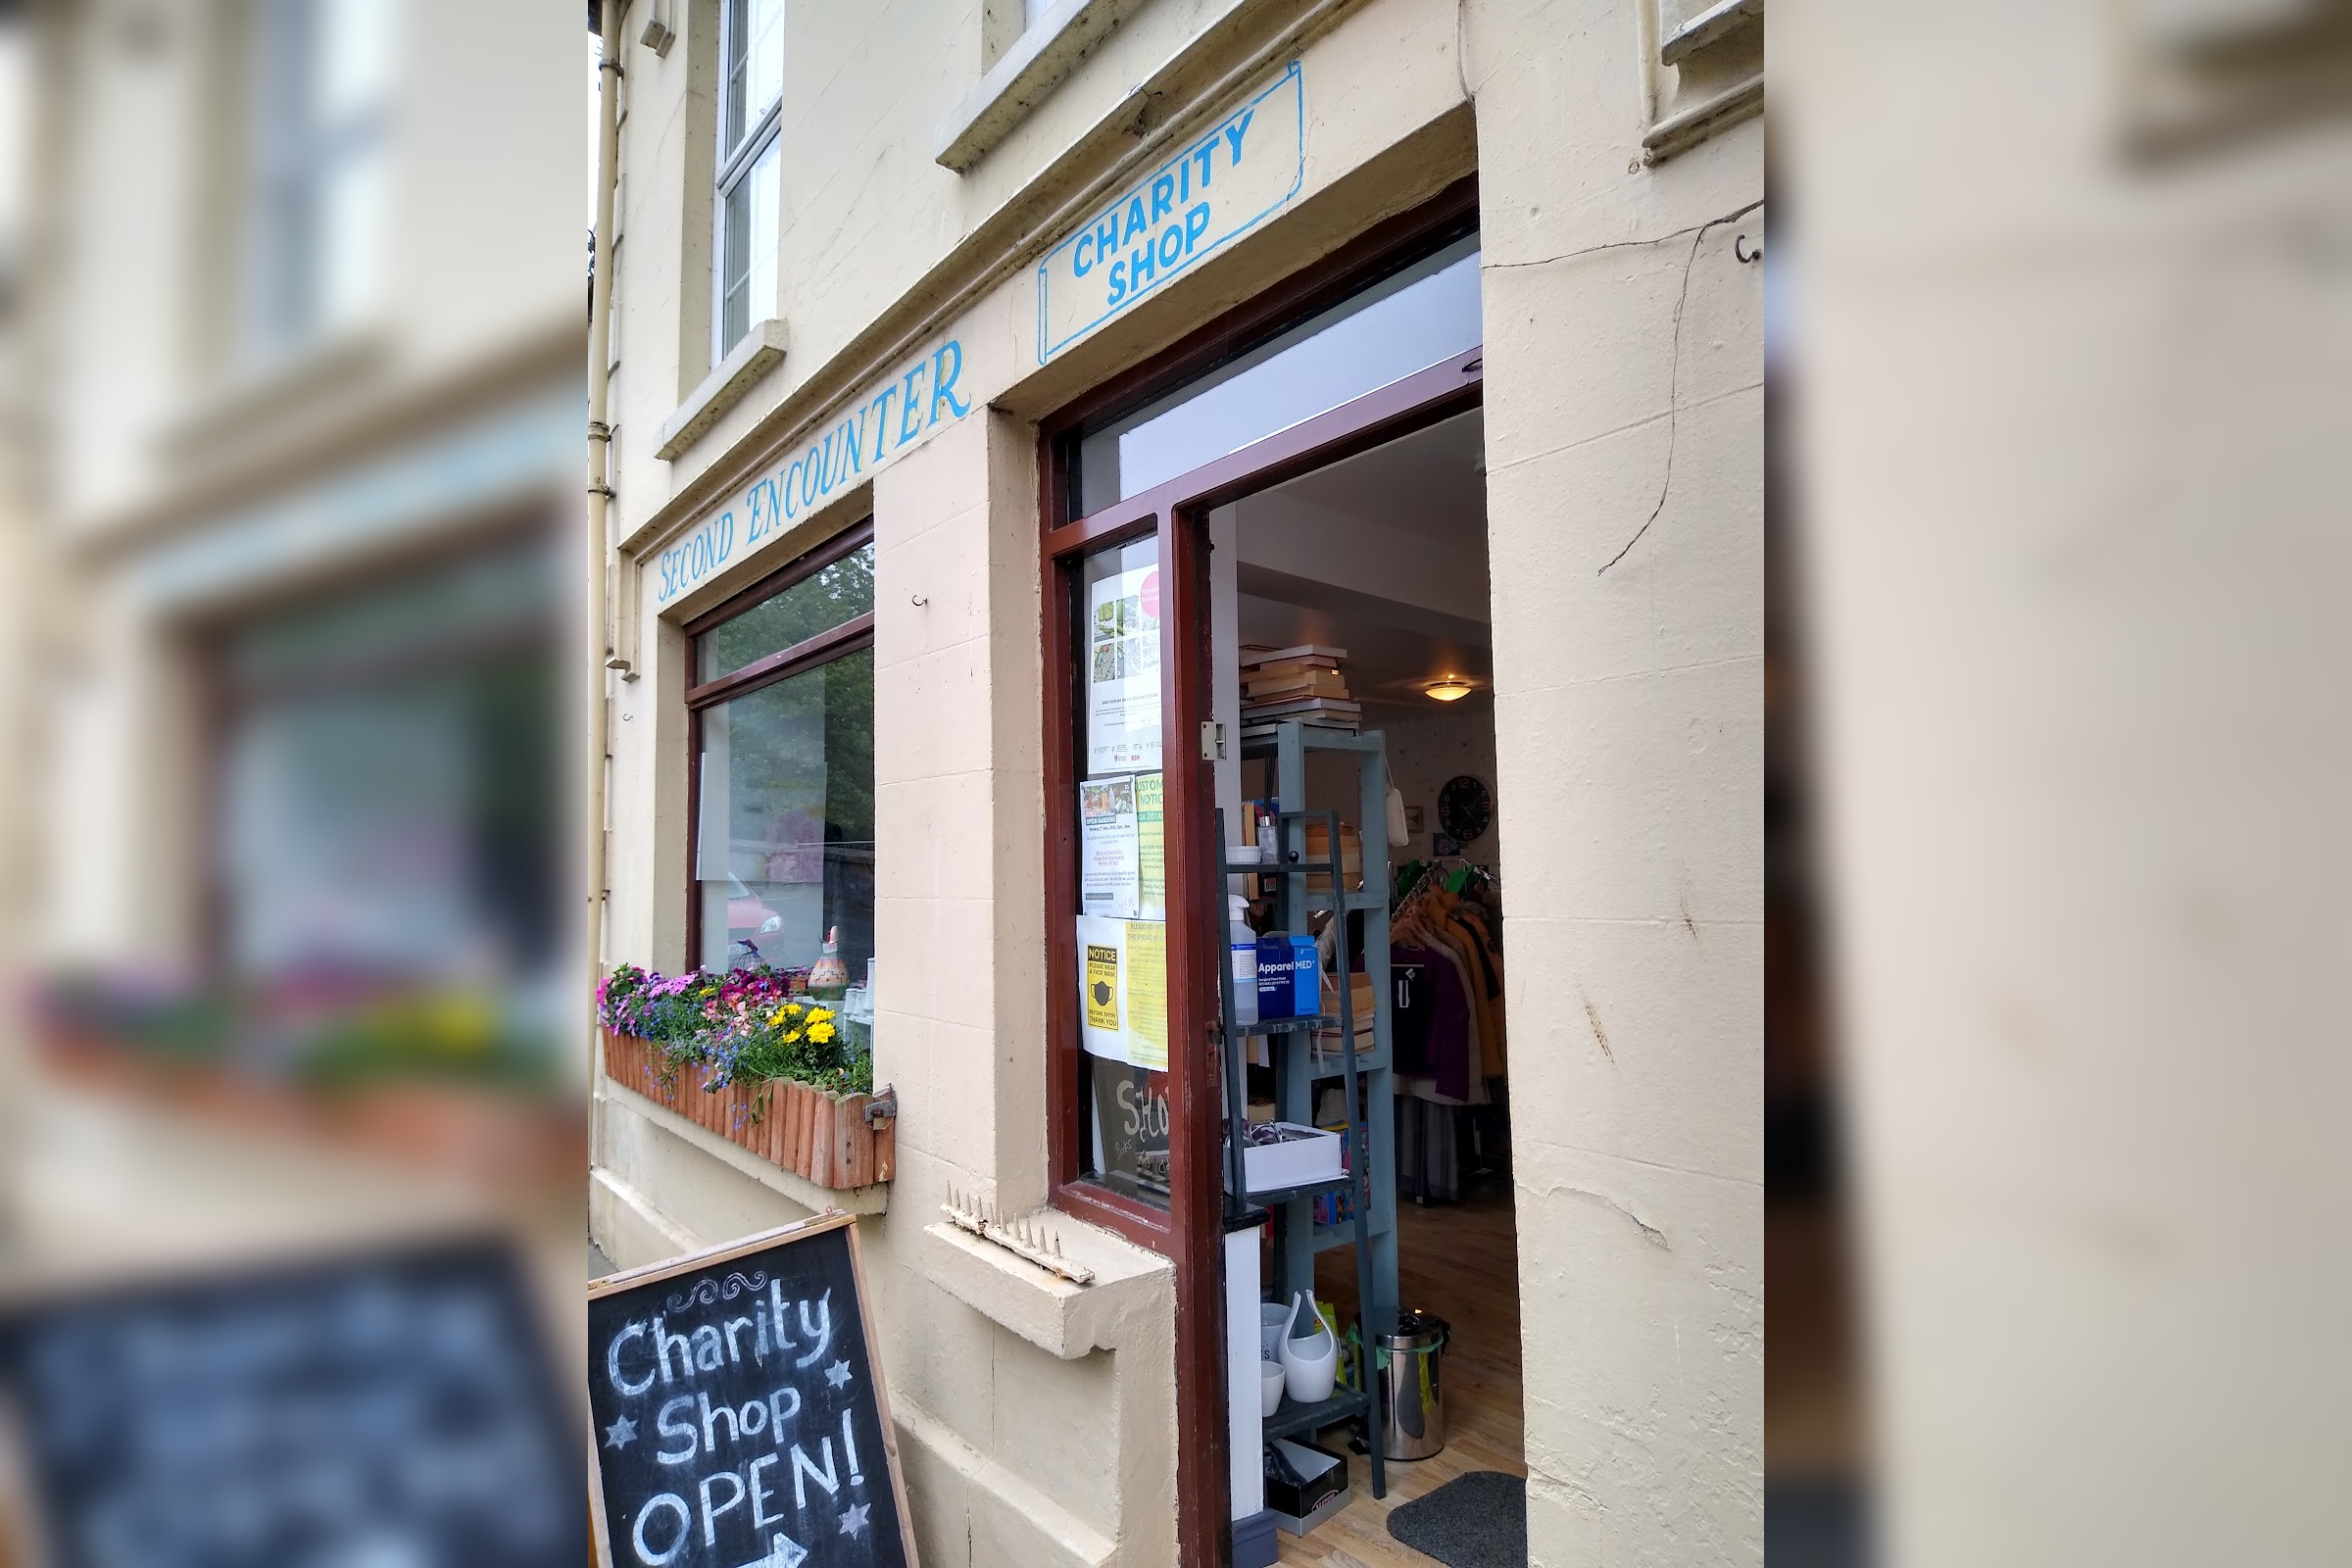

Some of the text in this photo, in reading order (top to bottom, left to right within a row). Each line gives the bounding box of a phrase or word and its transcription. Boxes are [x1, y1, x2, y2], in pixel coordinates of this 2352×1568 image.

[1072, 109, 1255, 279] CHARITY
[1106, 202, 1211, 306] SHOP
[659, 340, 971, 604] SECOND ENCOUNTER
[1136, 779, 1163, 792] USTOM
[1140, 793, 1163, 806] NOTIC
[1089, 949, 1116, 961] NOTICE
[1258, 961, 1294, 974] Apparel
[1090, 1015, 1105, 1024] THANK
[1117, 1080, 1169, 1141] SHO
[608, 1278, 832, 1396] Charity
[656, 1387, 802, 1465] Shop
[632, 1407, 865, 1566] OPEN!
